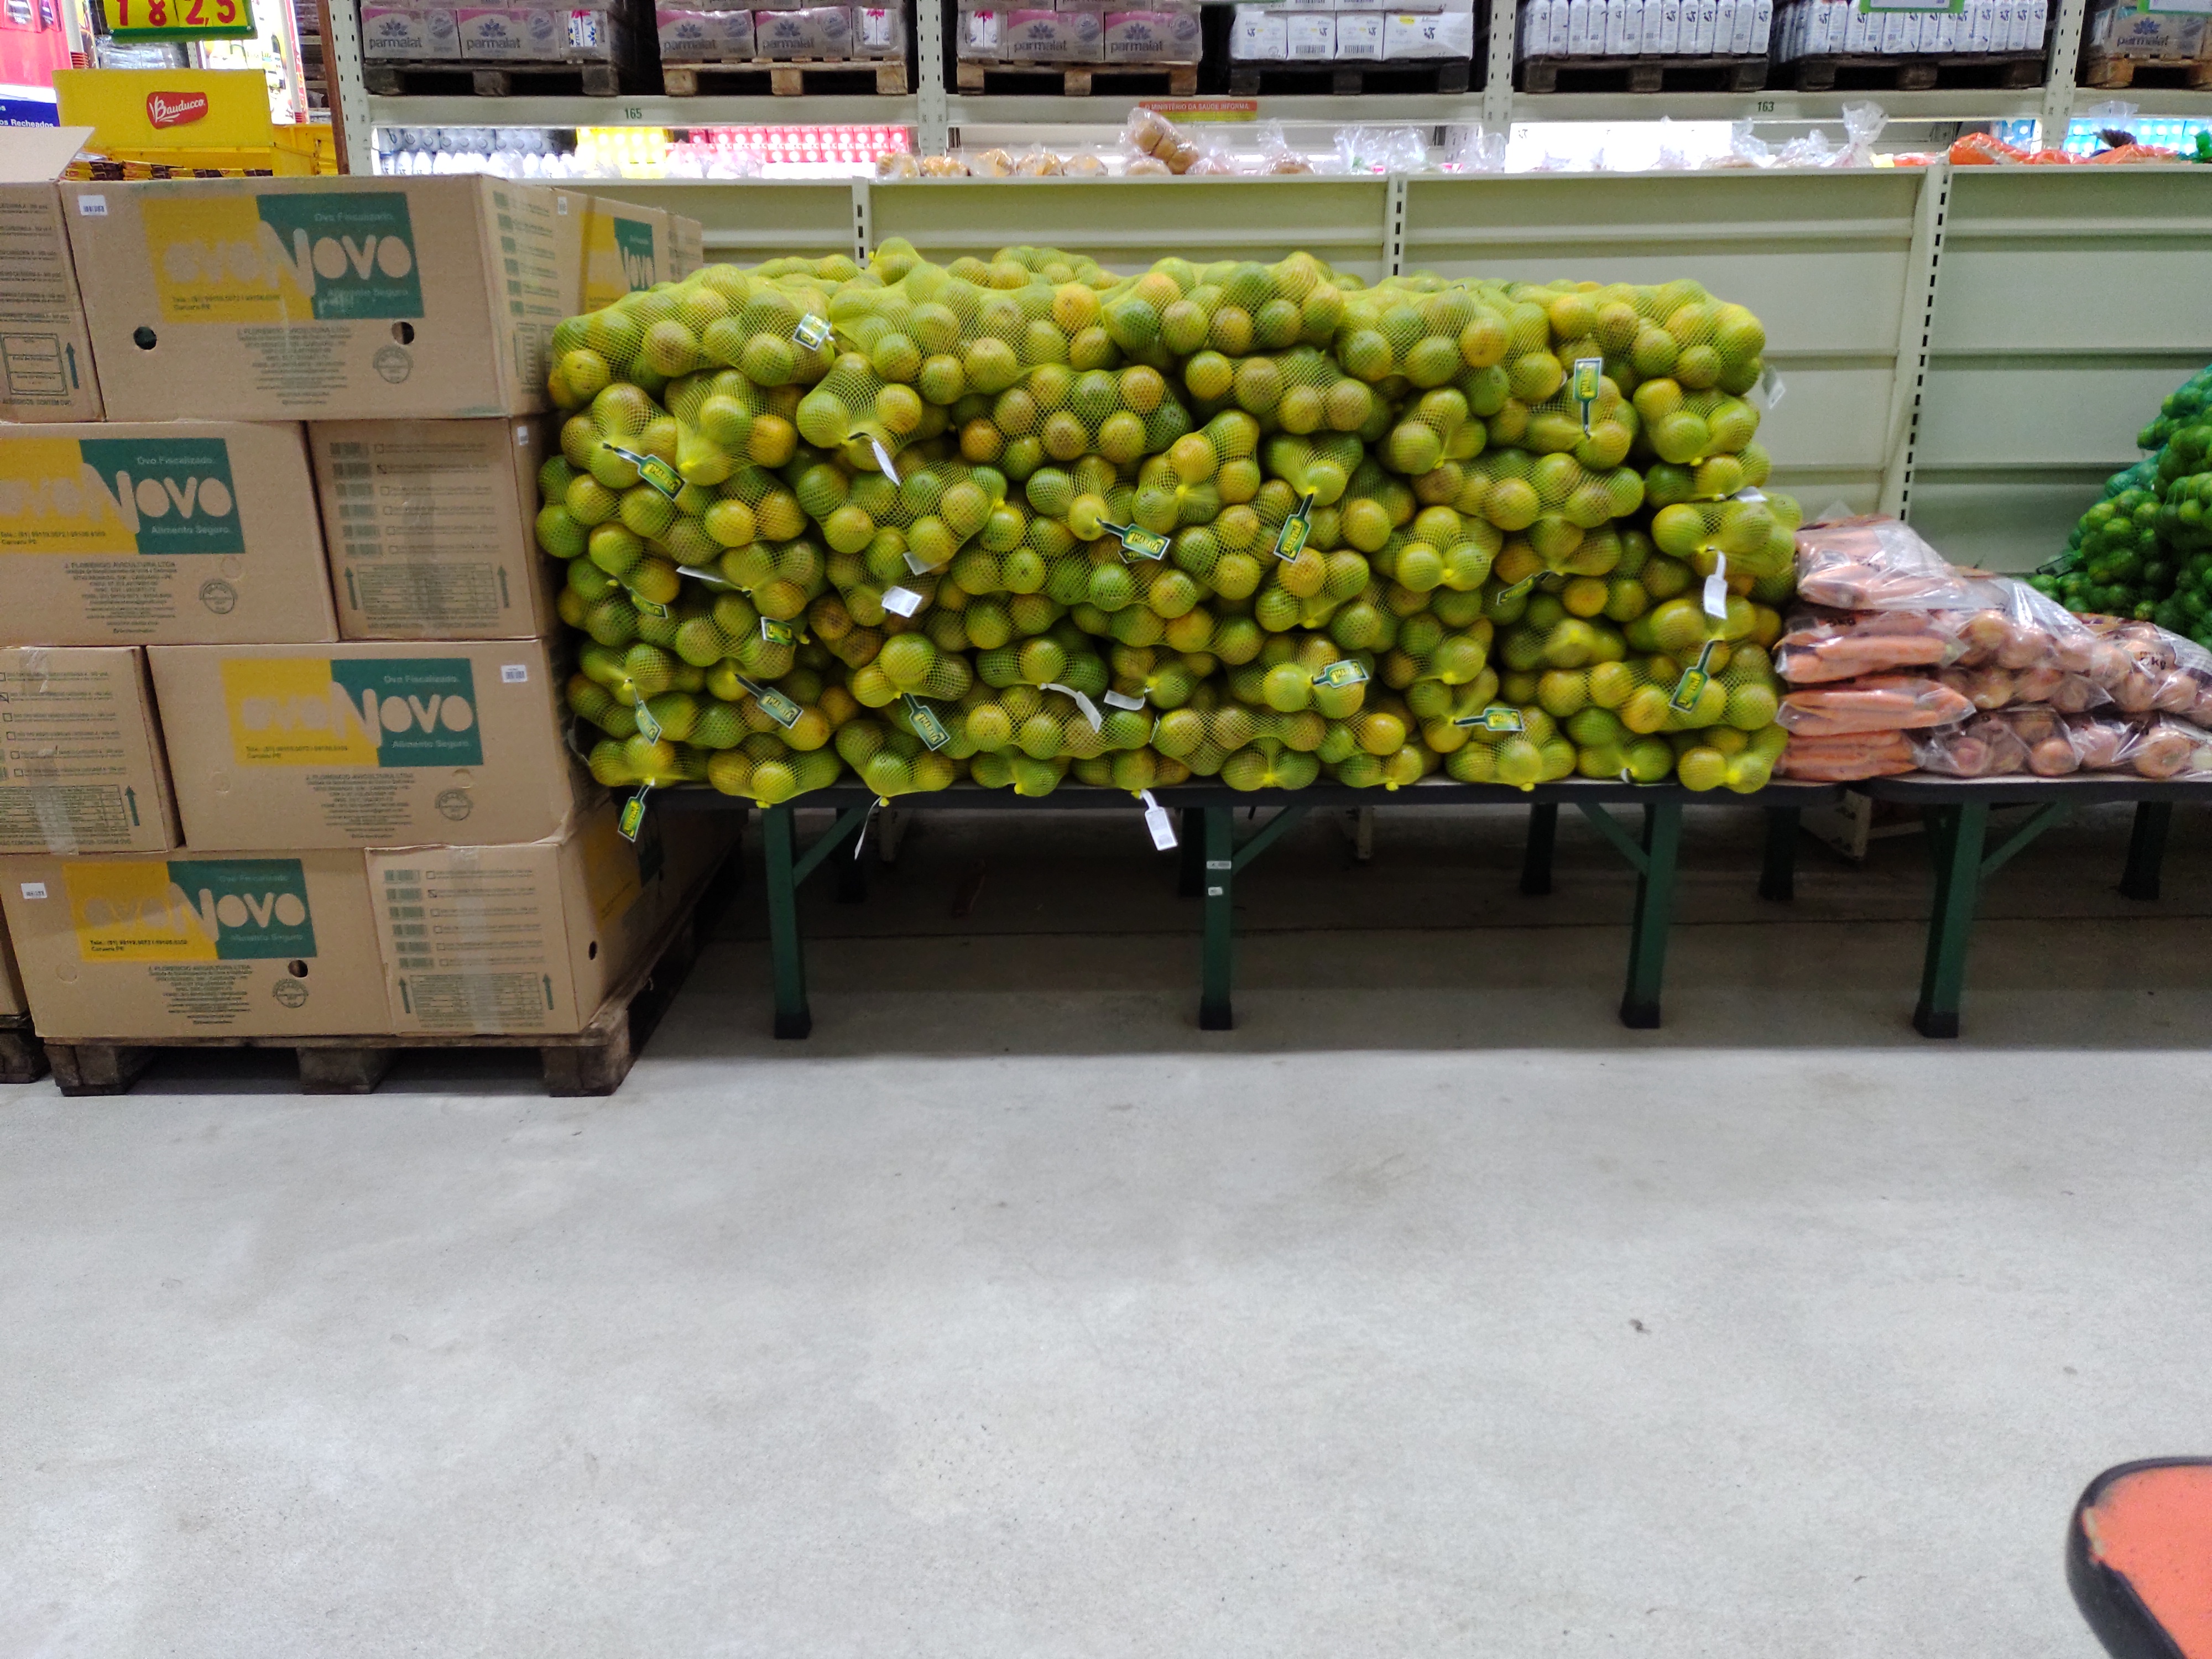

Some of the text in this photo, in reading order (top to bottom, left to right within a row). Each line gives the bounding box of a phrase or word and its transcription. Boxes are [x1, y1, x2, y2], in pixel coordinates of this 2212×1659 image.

[369, 37, 422, 50] parmalat
[466, 37, 520, 50] parmalat
[664, 39, 716, 53] parmalat
[1014, 39, 1067, 53] parmalat
[1110, 40, 1164, 53] parmalat
[149, 96, 205, 123] Bauducco
[1758, 101, 1774, 112] 163
[625, 108, 642, 119] 165
[11, 118, 54, 128] Recheados
